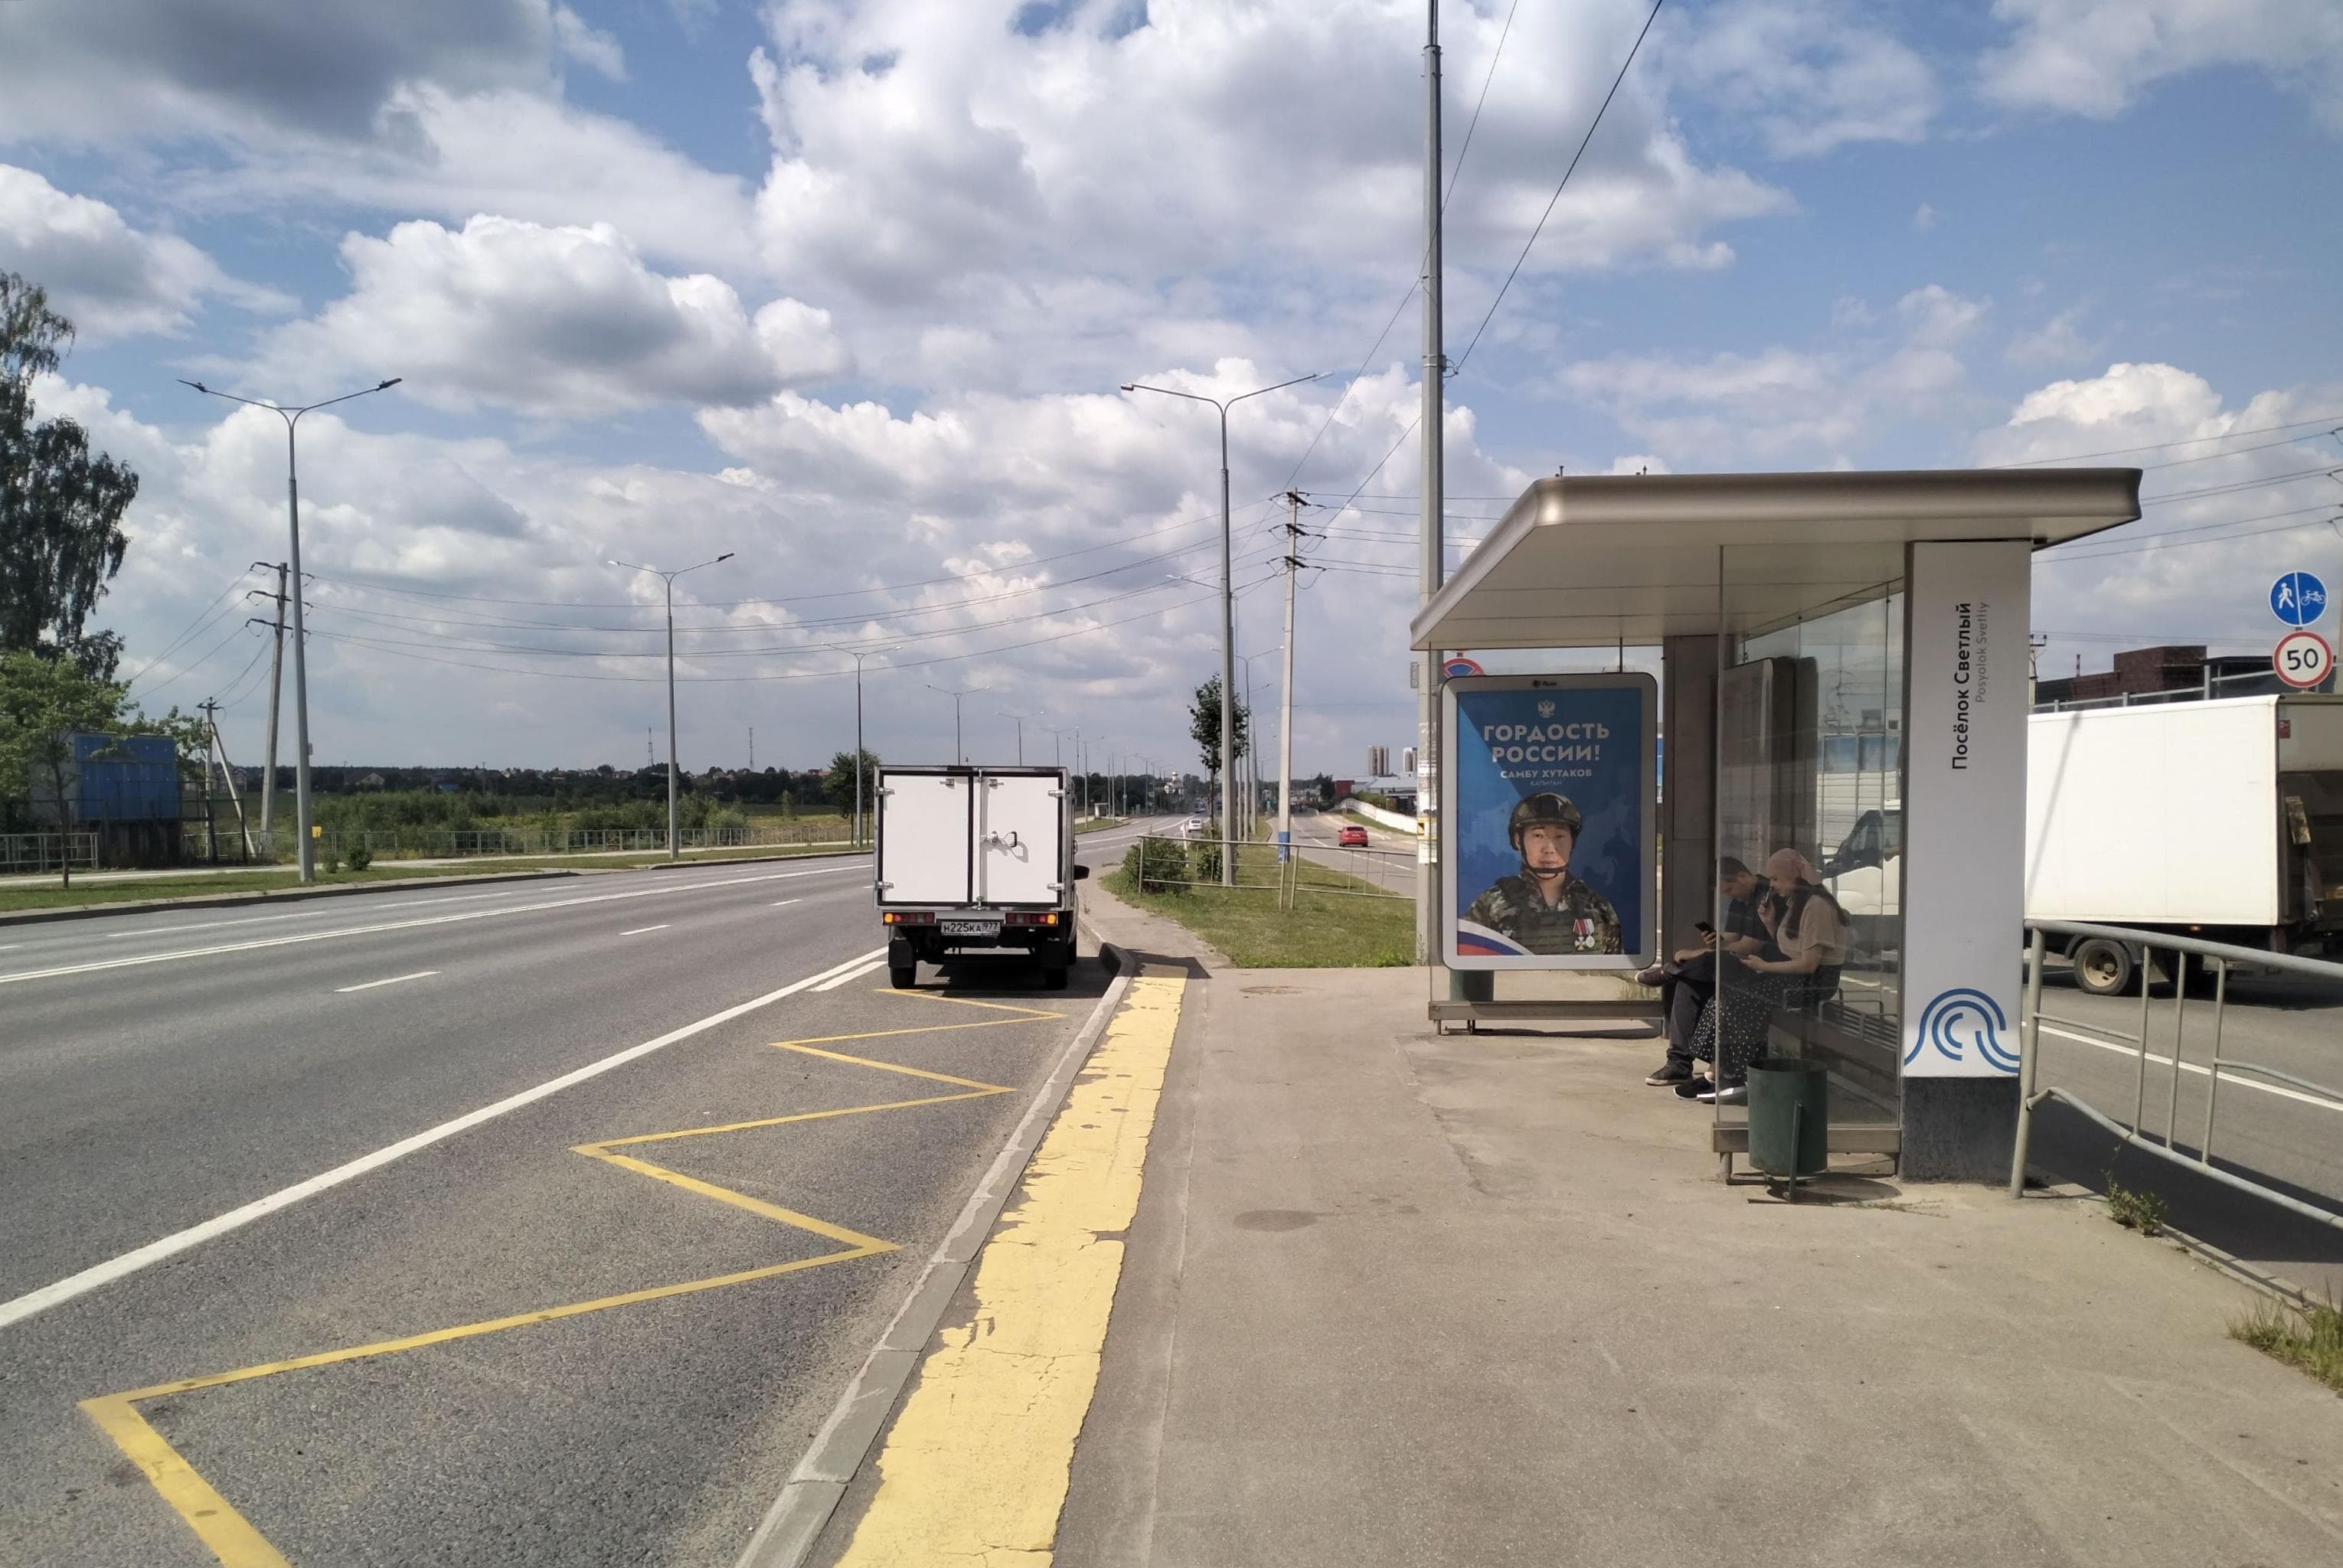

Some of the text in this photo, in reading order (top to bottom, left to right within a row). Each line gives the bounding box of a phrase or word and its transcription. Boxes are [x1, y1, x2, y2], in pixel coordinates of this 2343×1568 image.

[2286, 648, 2319, 671] 50
[1952, 603, 1972, 769] Посёлок Светлый
[1975, 648, 1988, 703] Posyolok
[1483, 723, 1610, 743] ГОРДОСТЬ
[1492, 744, 1600, 763] РОССИИ!
[1500, 769, 1593, 779] САМБУ ХУТАКОВ
